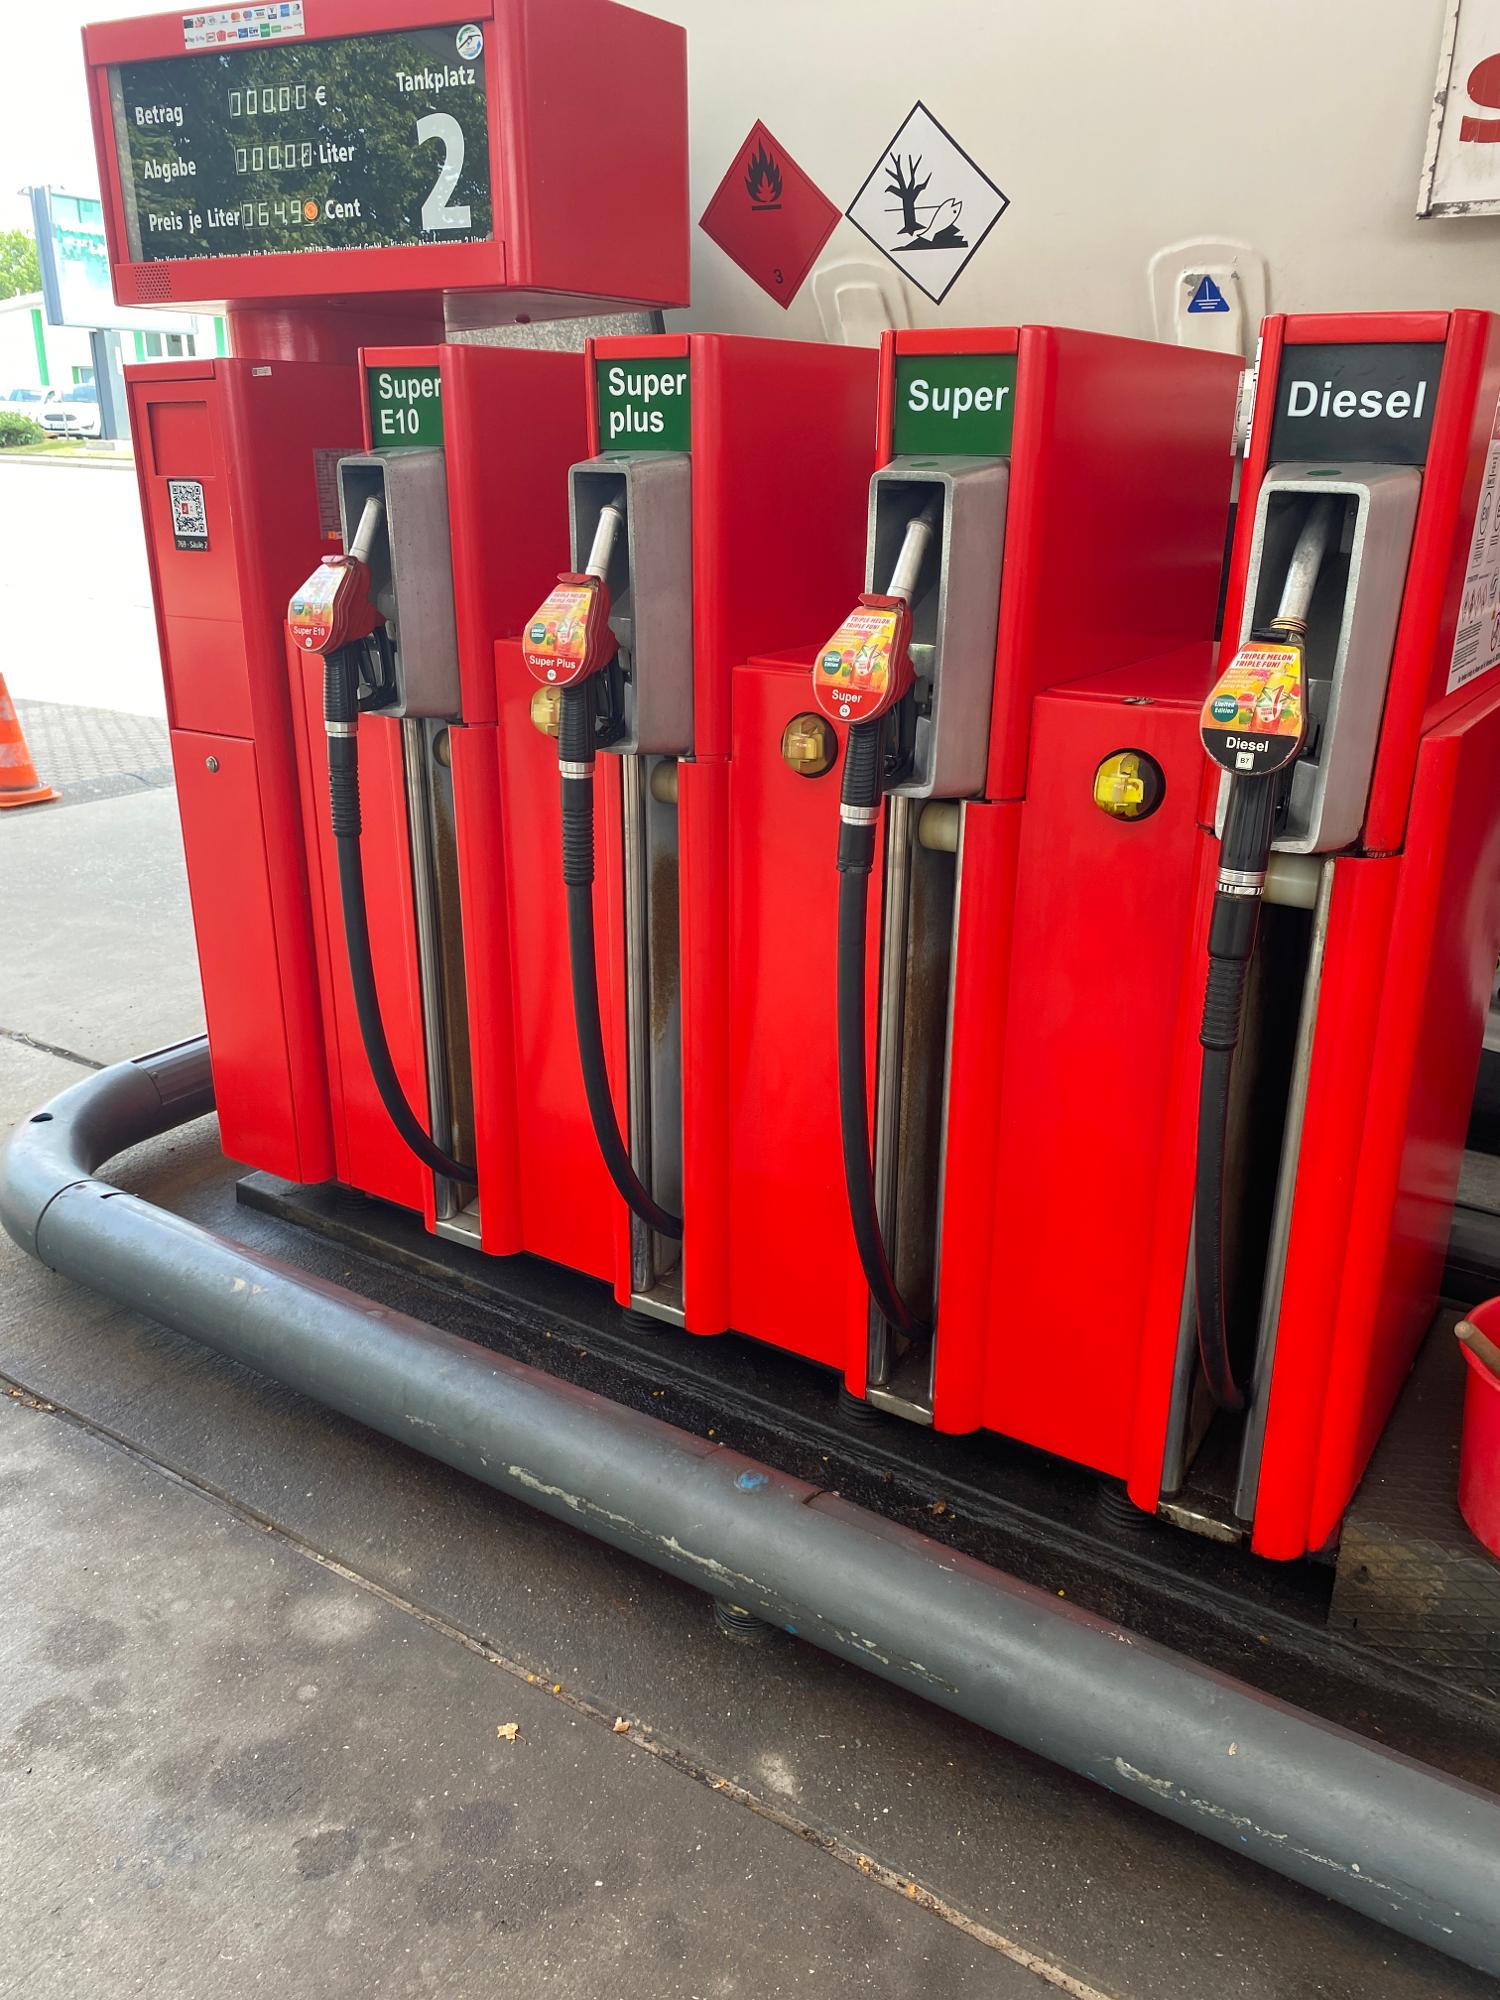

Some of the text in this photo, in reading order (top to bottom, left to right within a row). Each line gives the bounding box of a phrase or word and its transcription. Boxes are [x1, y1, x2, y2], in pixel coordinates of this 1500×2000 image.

[396, 65, 476, 94] Tankplatz
[135, 106, 183, 127] Betrag
[315, 86, 327, 106] €
[144, 157, 196, 183] Abgabe
[319, 143, 355, 164] Liter
[416, 112, 472, 230] 2
[149, 199, 361, 234] Preis je Liter 064,9 Cent
[774, 268, 784, 285] 3
[379, 373, 442, 404] Super
[608, 367, 687, 403] Super
[908, 379, 1010, 419] Super
[1287, 381, 1427, 418] Diesel
[380, 408, 420, 434] E10
[610, 404, 665, 439] plus
[293, 626, 325, 637] Super E10
[529, 655, 576, 669] Super Plus
[832, 689, 862, 704] Super
[1214, 700, 1236, 708] Limited
[1226, 736, 1269, 752] Diesel
[1240, 756, 1250, 764] B7
